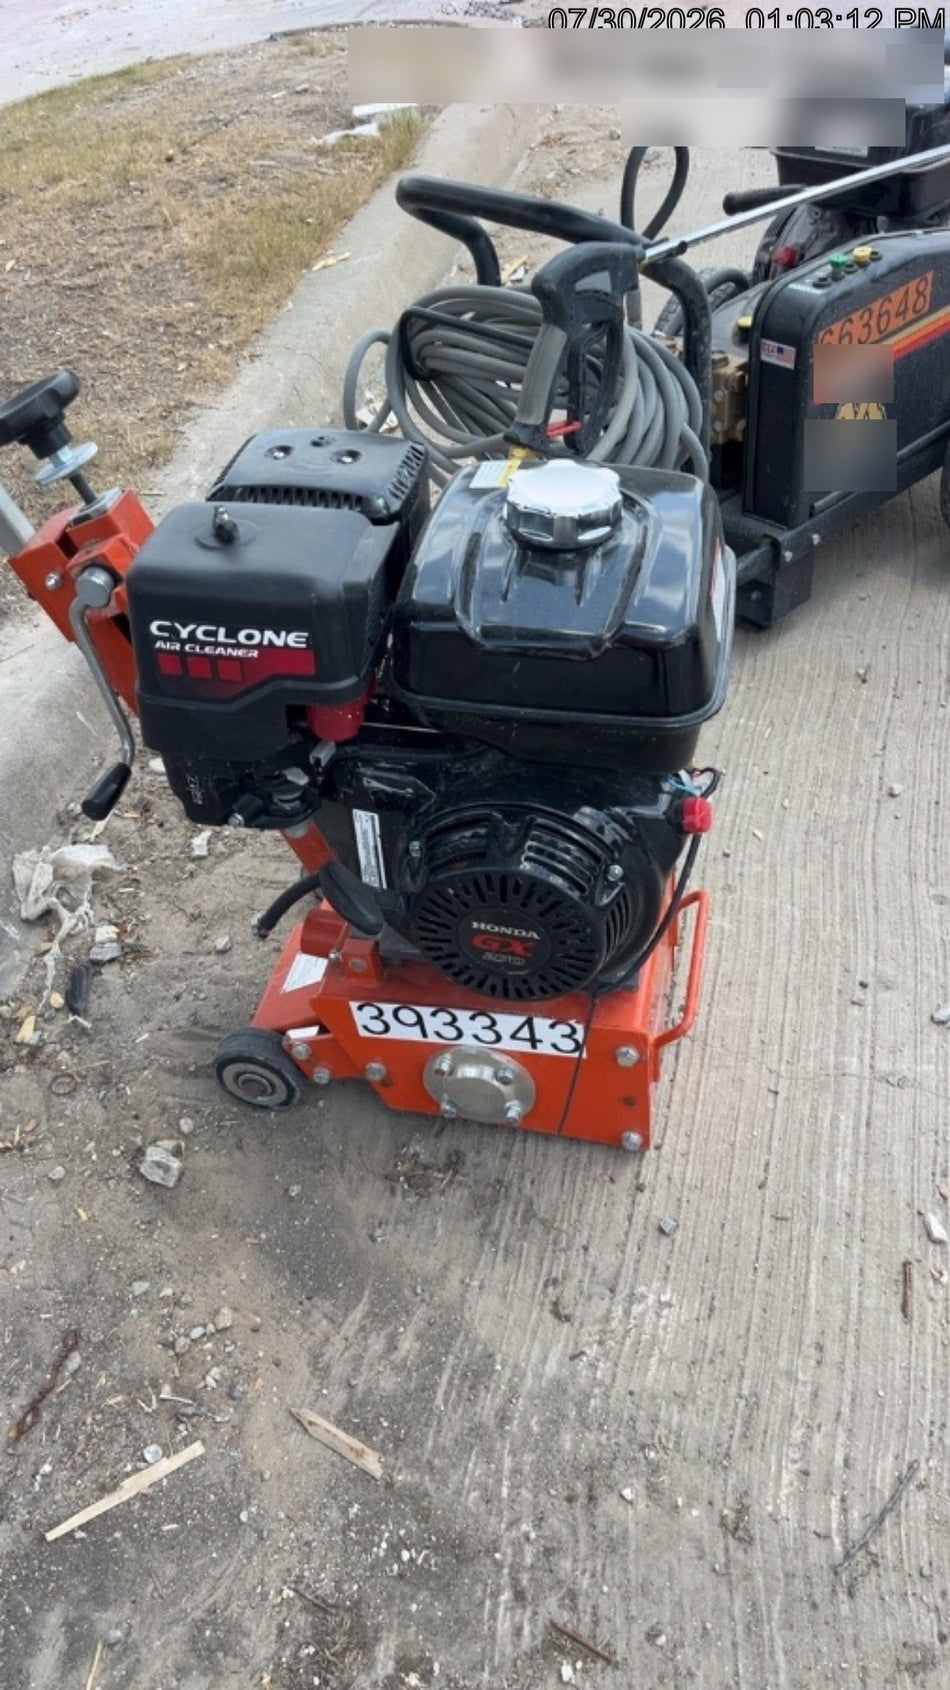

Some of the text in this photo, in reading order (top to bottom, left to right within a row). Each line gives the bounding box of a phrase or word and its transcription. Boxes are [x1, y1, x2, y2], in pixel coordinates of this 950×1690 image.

[150, 620, 309, 648] CYCLONE
[154, 640, 259, 658] AIR CLEANER
[472, 921, 541, 939] HONDA
[472, 933, 538, 957] GX
[356, 1002, 582, 1054] 393343
